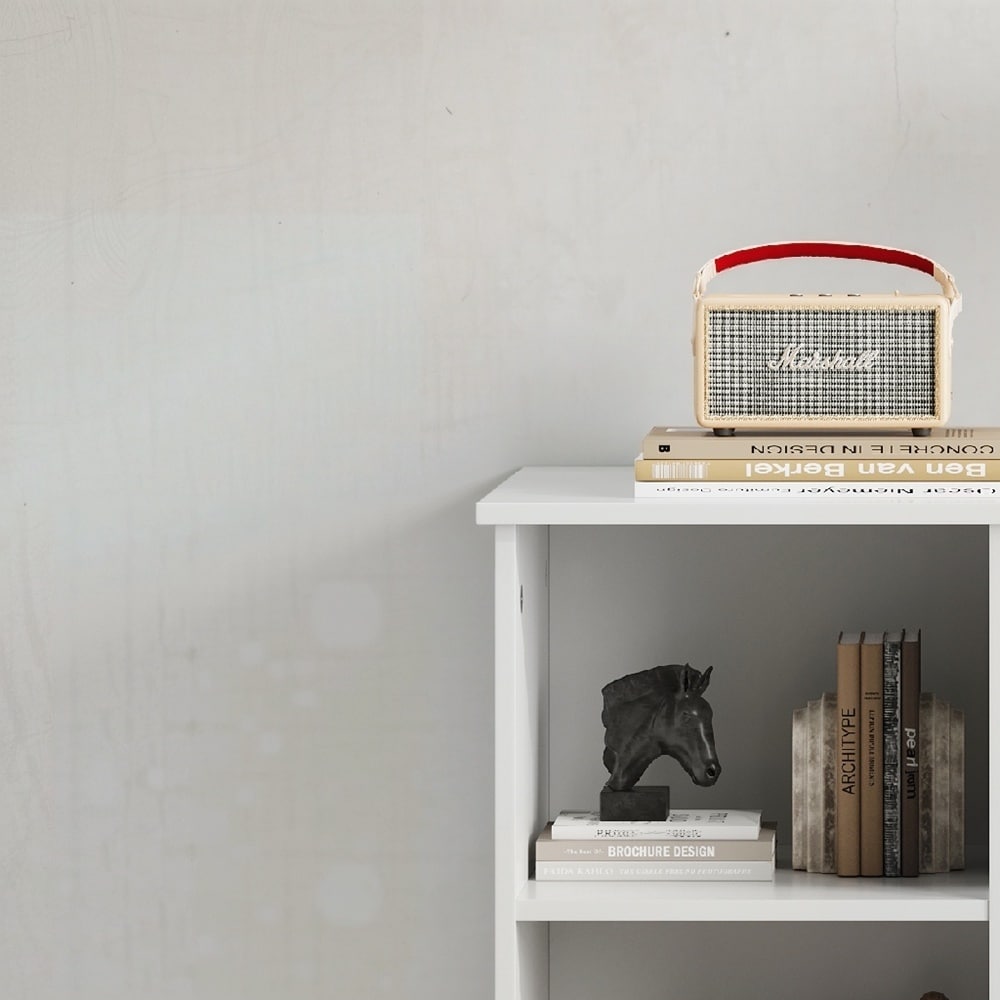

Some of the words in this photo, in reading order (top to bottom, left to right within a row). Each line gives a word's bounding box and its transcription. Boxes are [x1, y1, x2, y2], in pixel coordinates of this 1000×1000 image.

[769, 345, 878, 371] Marshall
[751, 444, 835, 454] DESIGN
[842, 444, 862, 454] IN
[871, 444, 995, 454] CONCRETE
[745, 462, 845, 478] Berkel
[858, 462, 915, 475] van
[926, 462, 986, 478] Ben
[797, 486, 914, 495] Niemeyer
[924, 486, 997, 494] Oscar
[841, 707, 856, 795] ARCHITYPE
[904, 727, 918, 768] pearl
[607, 845, 671, 857] BROCHURE
[673, 845, 716, 857] DESIGN
